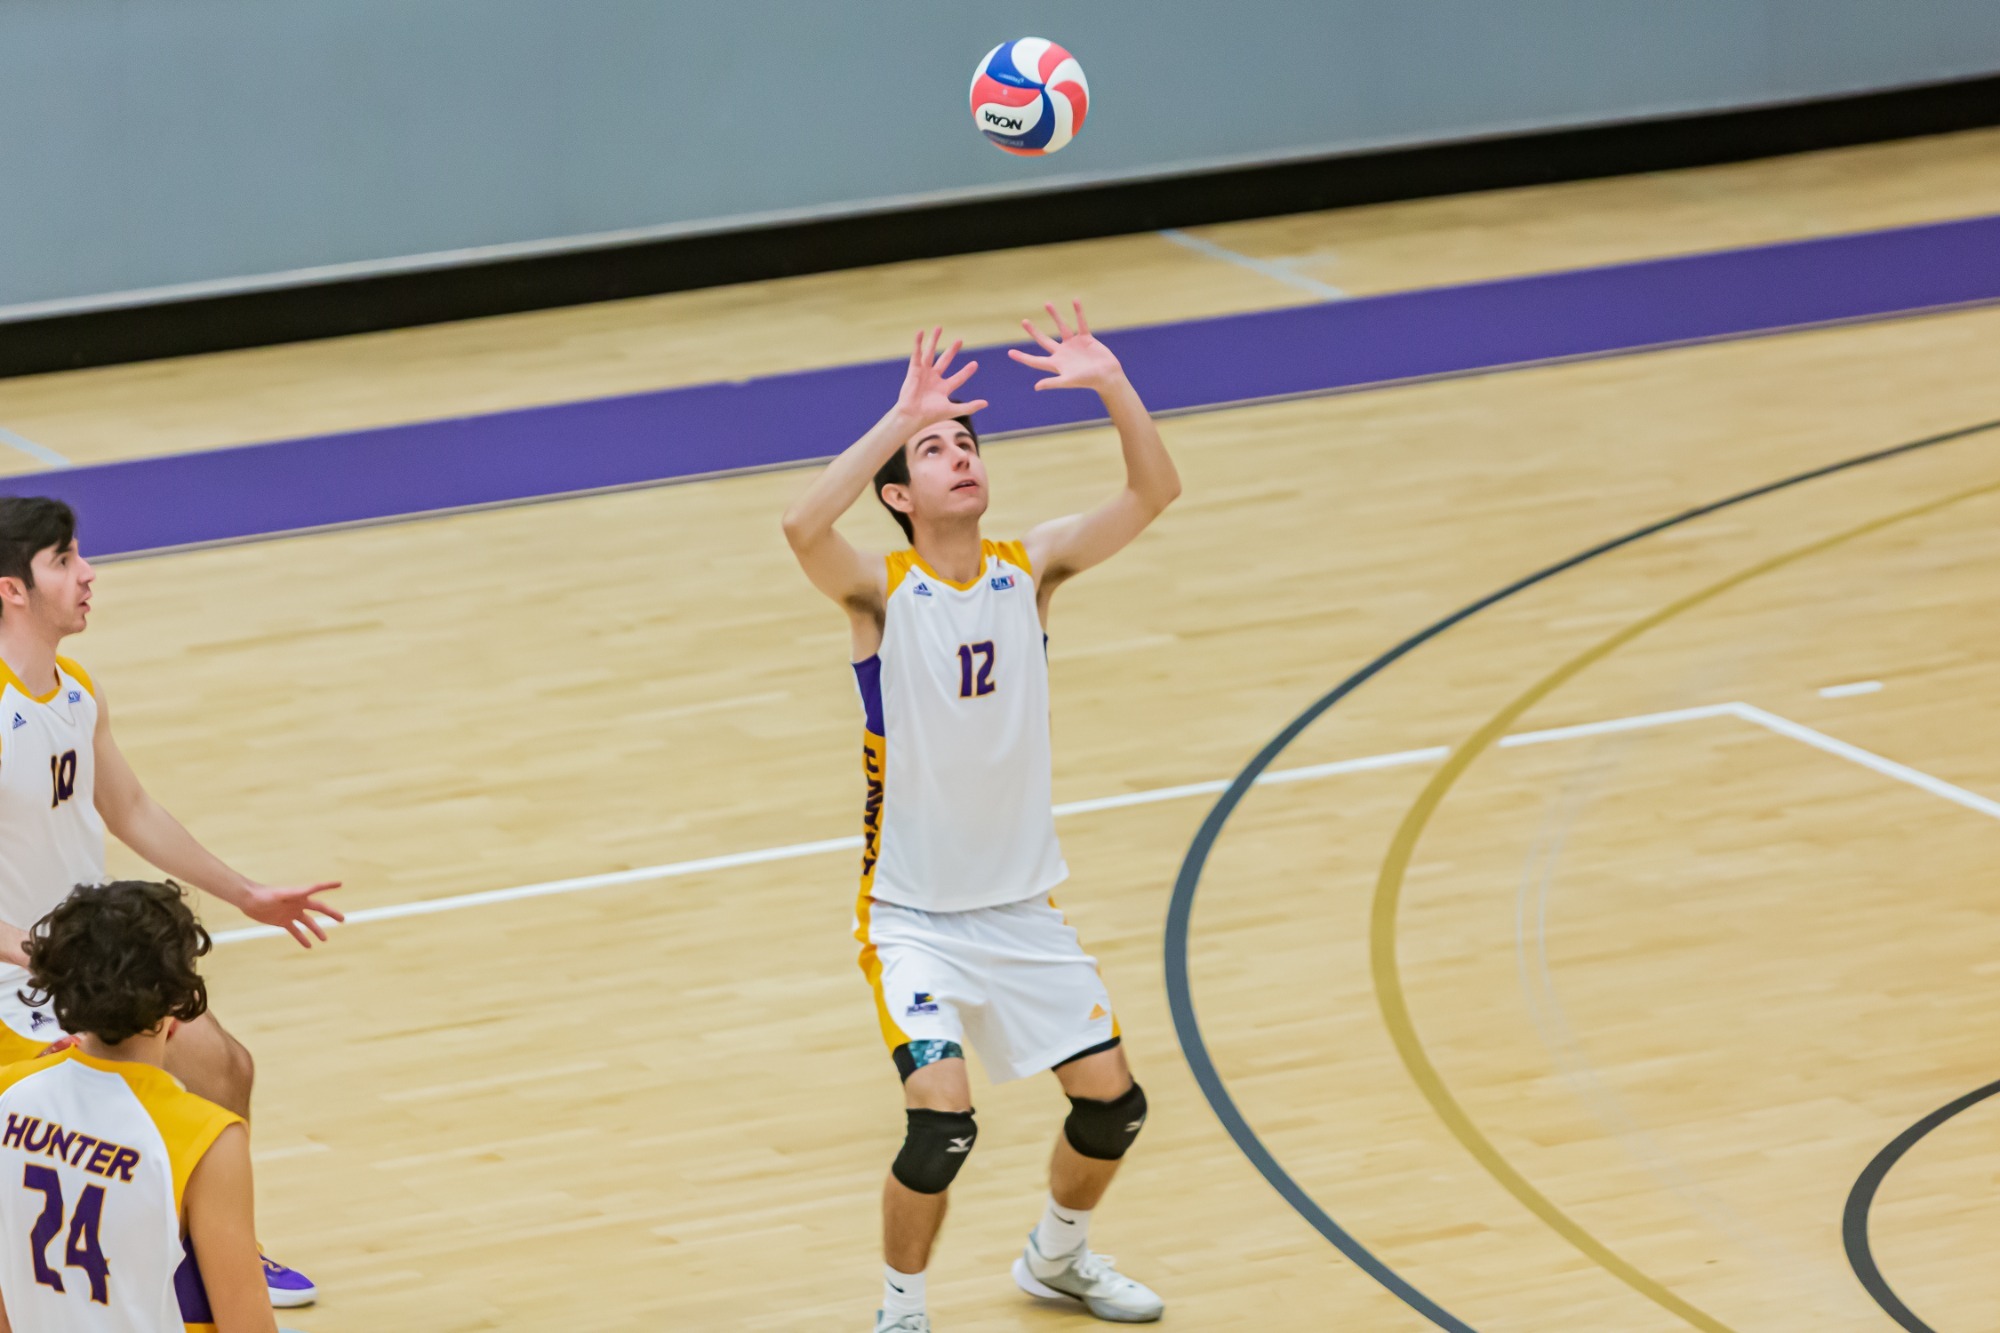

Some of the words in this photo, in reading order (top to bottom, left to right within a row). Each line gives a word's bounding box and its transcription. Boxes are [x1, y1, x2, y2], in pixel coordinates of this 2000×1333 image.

[985, 110, 1023, 131] NCAA
[957, 640, 996, 698] 12
[50, 748, 77, 810] 10
[2, 1112, 142, 1184] HUNTER
[22, 1161, 111, 1307] 24
